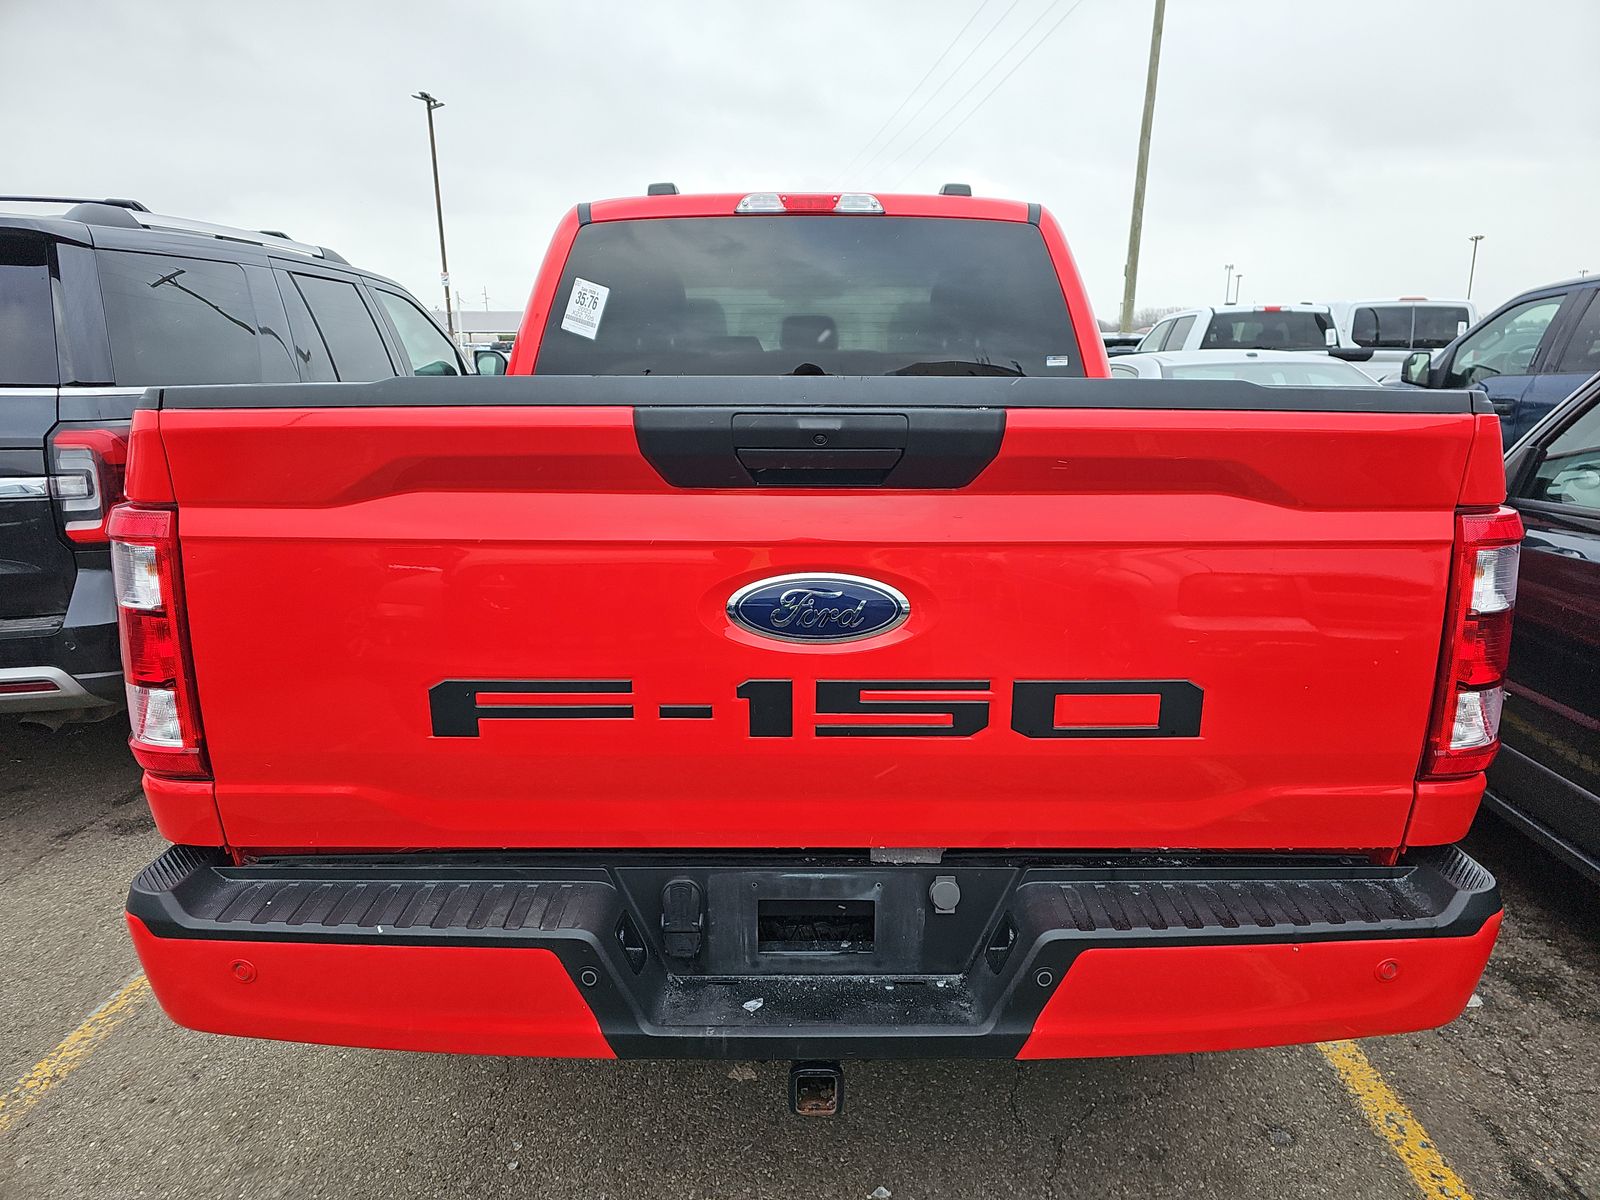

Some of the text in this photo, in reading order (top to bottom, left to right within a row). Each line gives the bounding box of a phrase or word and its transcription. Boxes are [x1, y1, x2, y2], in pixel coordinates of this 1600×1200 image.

[576, 291, 599, 310] 35:76
[770, 588, 867, 628] Ford
[428, 679, 1204, 738] F-150
